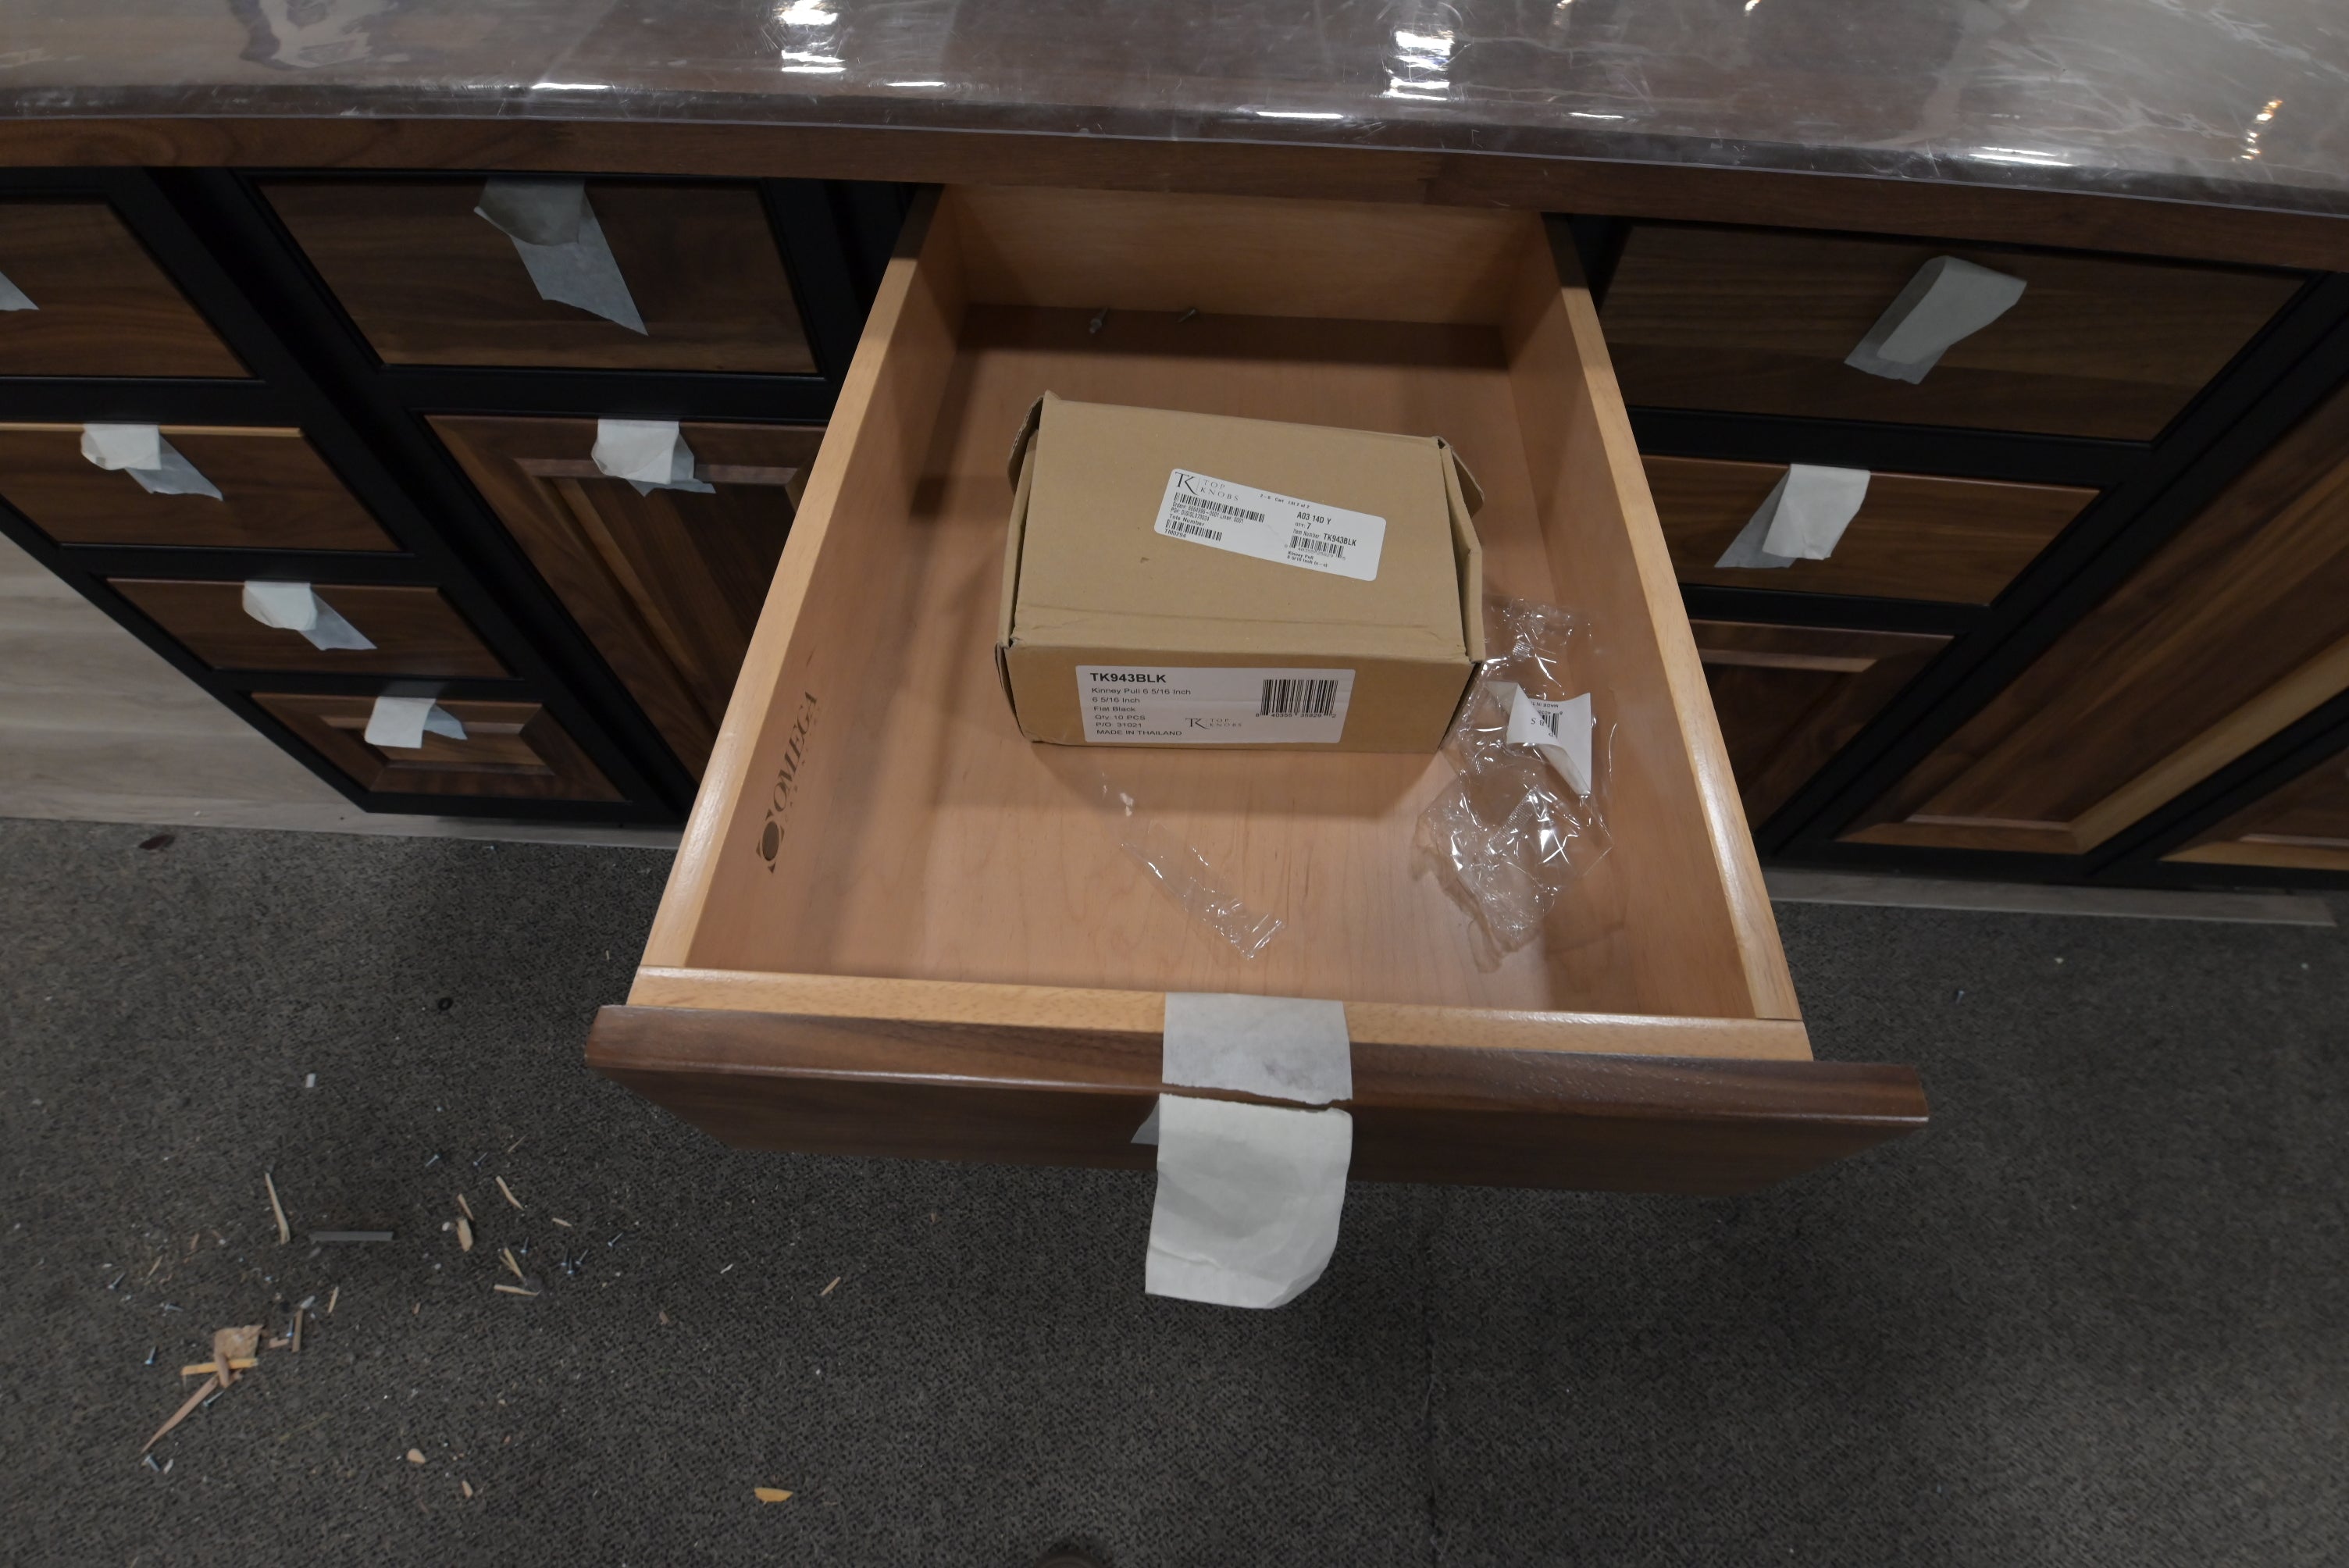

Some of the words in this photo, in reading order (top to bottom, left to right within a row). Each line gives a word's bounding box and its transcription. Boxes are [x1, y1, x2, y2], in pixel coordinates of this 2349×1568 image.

[1204, 479, 1224, 489] TOP
[1200, 487, 1239, 501] KNOBS
[1182, 516, 1204, 526] Number
[1296, 511, 1310, 521] A03
[1313, 515, 1324, 524] 14D
[1164, 529, 1186, 538] TM0294
[1324, 533, 1356, 547] TK943BLK
[1090, 672, 1167, 683] TK943BLK
[773, 691, 817, 812] OMEGA
